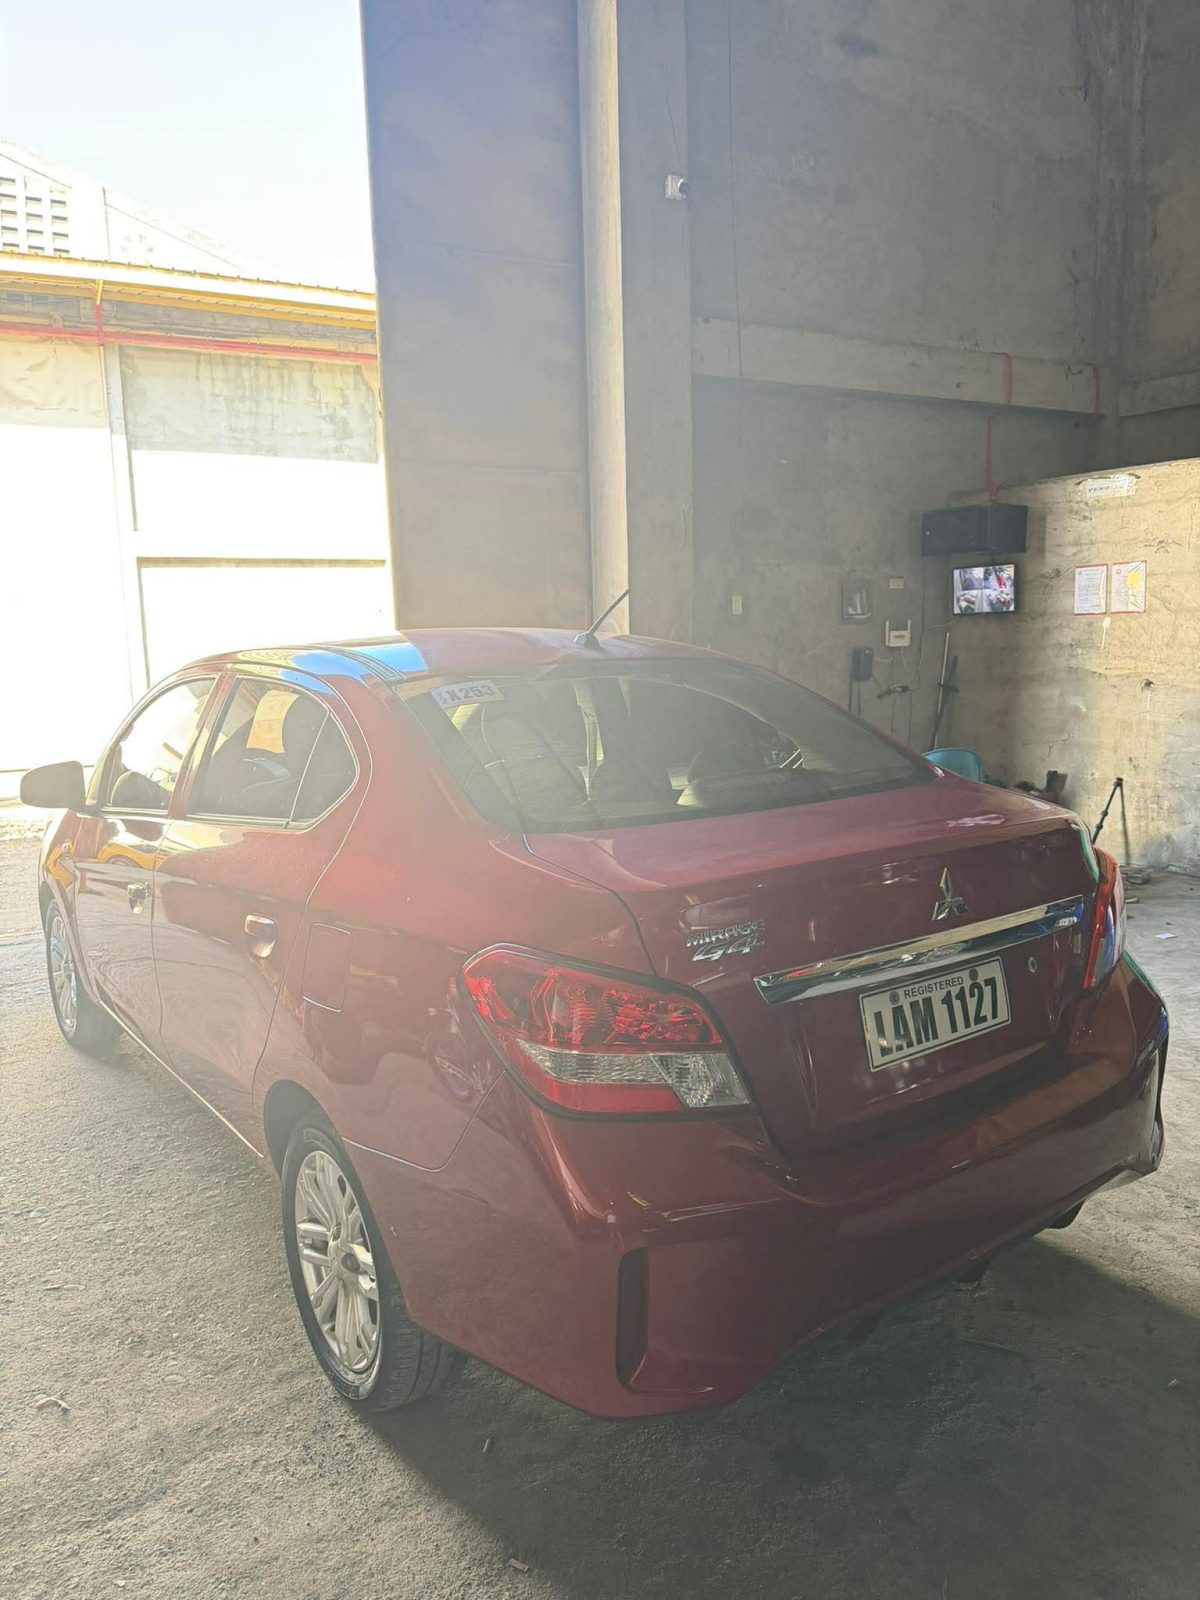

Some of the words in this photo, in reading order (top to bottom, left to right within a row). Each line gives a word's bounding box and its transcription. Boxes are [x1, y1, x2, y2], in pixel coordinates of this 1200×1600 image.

[686, 919, 765, 947] MIRAGE
[691, 933, 763, 962] G4
[903, 976, 965, 1000] REGISTERED
[873, 996, 939, 1058] LAM
[941, 976, 999, 1034] 1127
